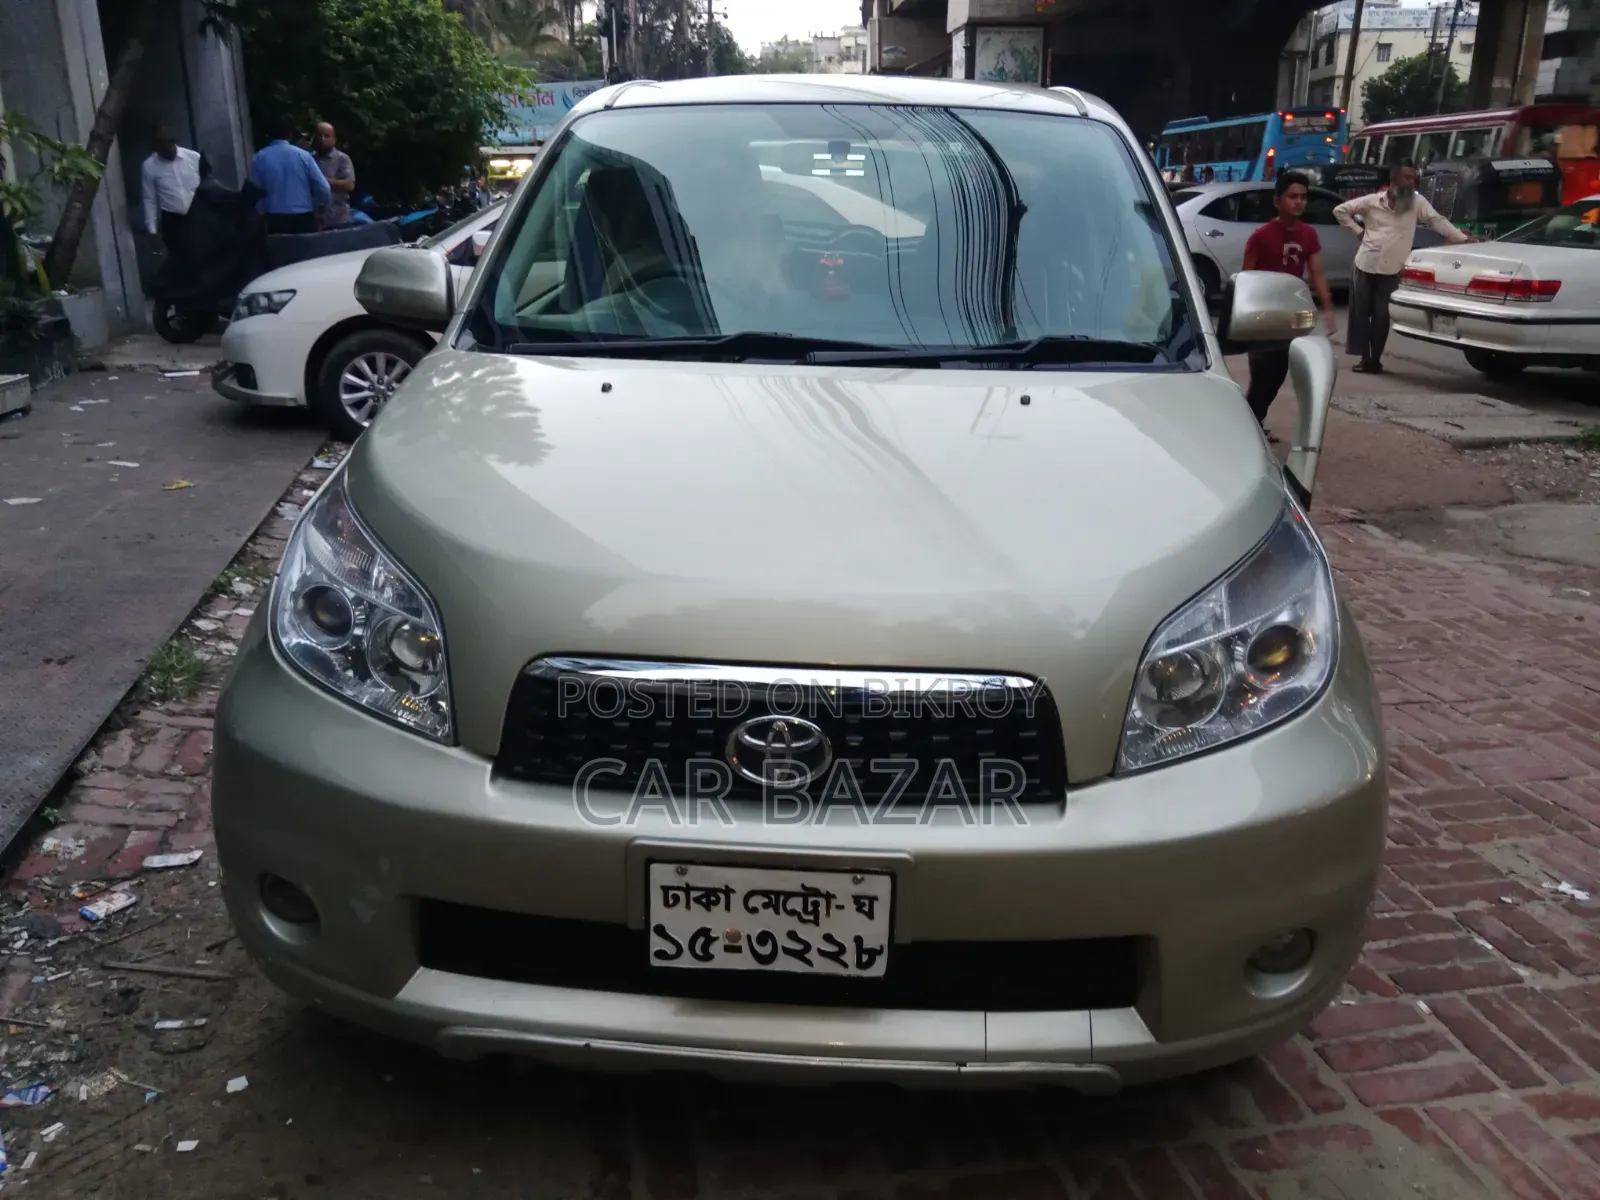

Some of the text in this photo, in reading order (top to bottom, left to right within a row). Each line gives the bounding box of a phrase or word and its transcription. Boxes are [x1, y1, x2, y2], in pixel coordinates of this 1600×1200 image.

[659, 882, 736, 912] ঢাকা
[852, 895, 879, 920] ঘ
[652, 923, 884, 971] ১৫-৩২২৮
